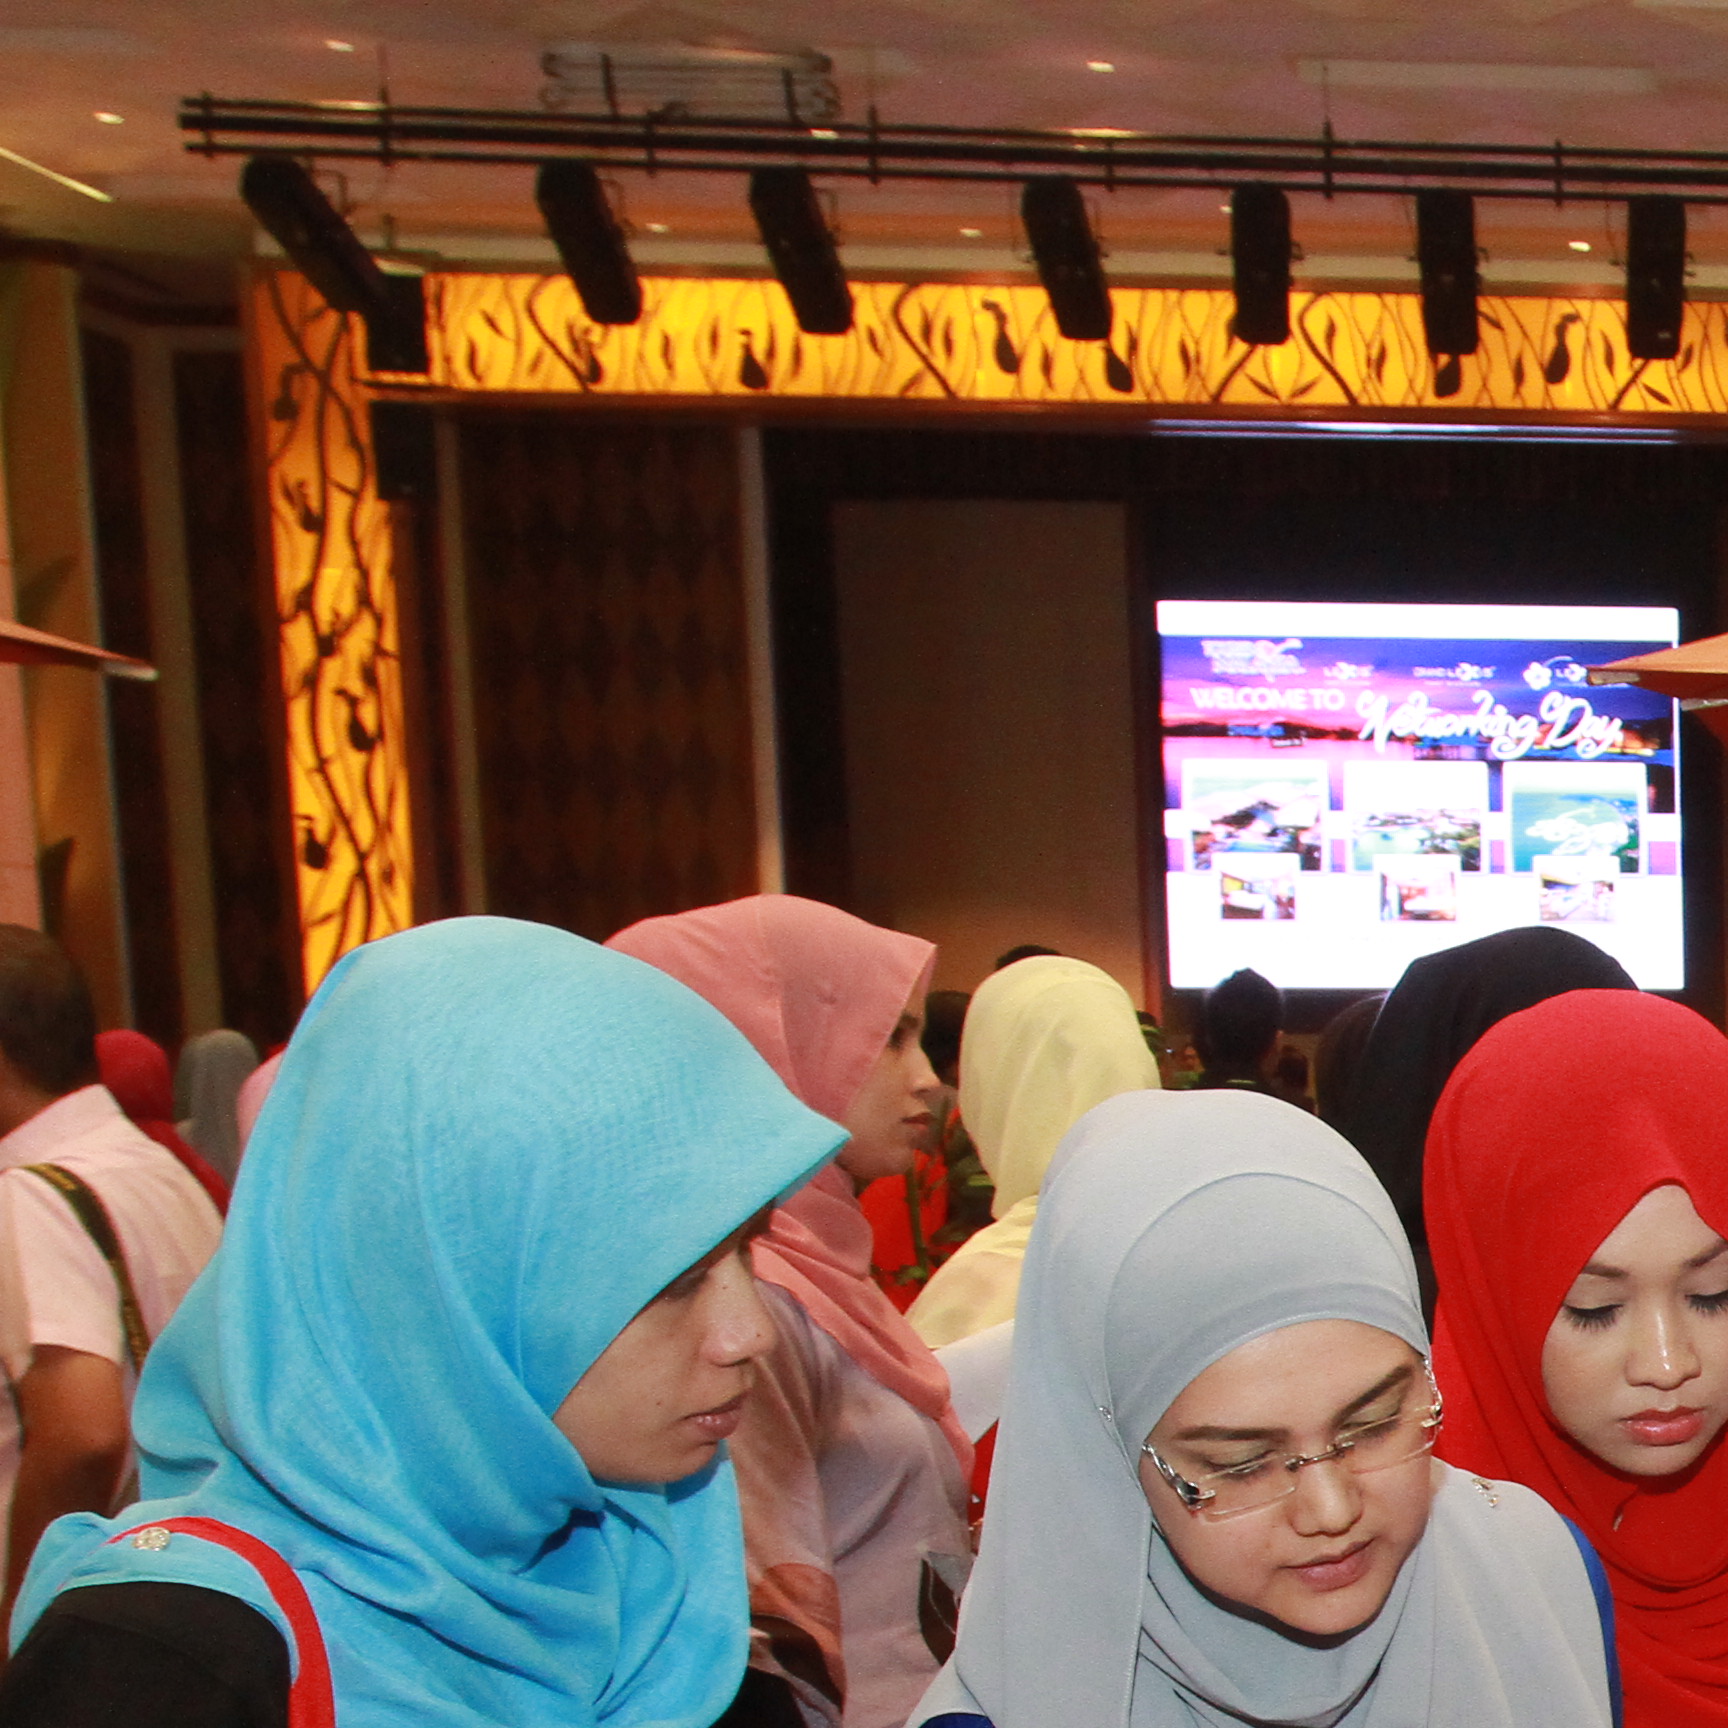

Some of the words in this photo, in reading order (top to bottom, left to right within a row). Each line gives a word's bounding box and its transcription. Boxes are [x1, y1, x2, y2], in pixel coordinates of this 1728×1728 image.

[1190, 687, 1307, 710] WELCOME
[1308, 688, 1345, 711] TO
[1355, 690, 1540, 760] Networking
[1540, 691, 1622, 759] Day
